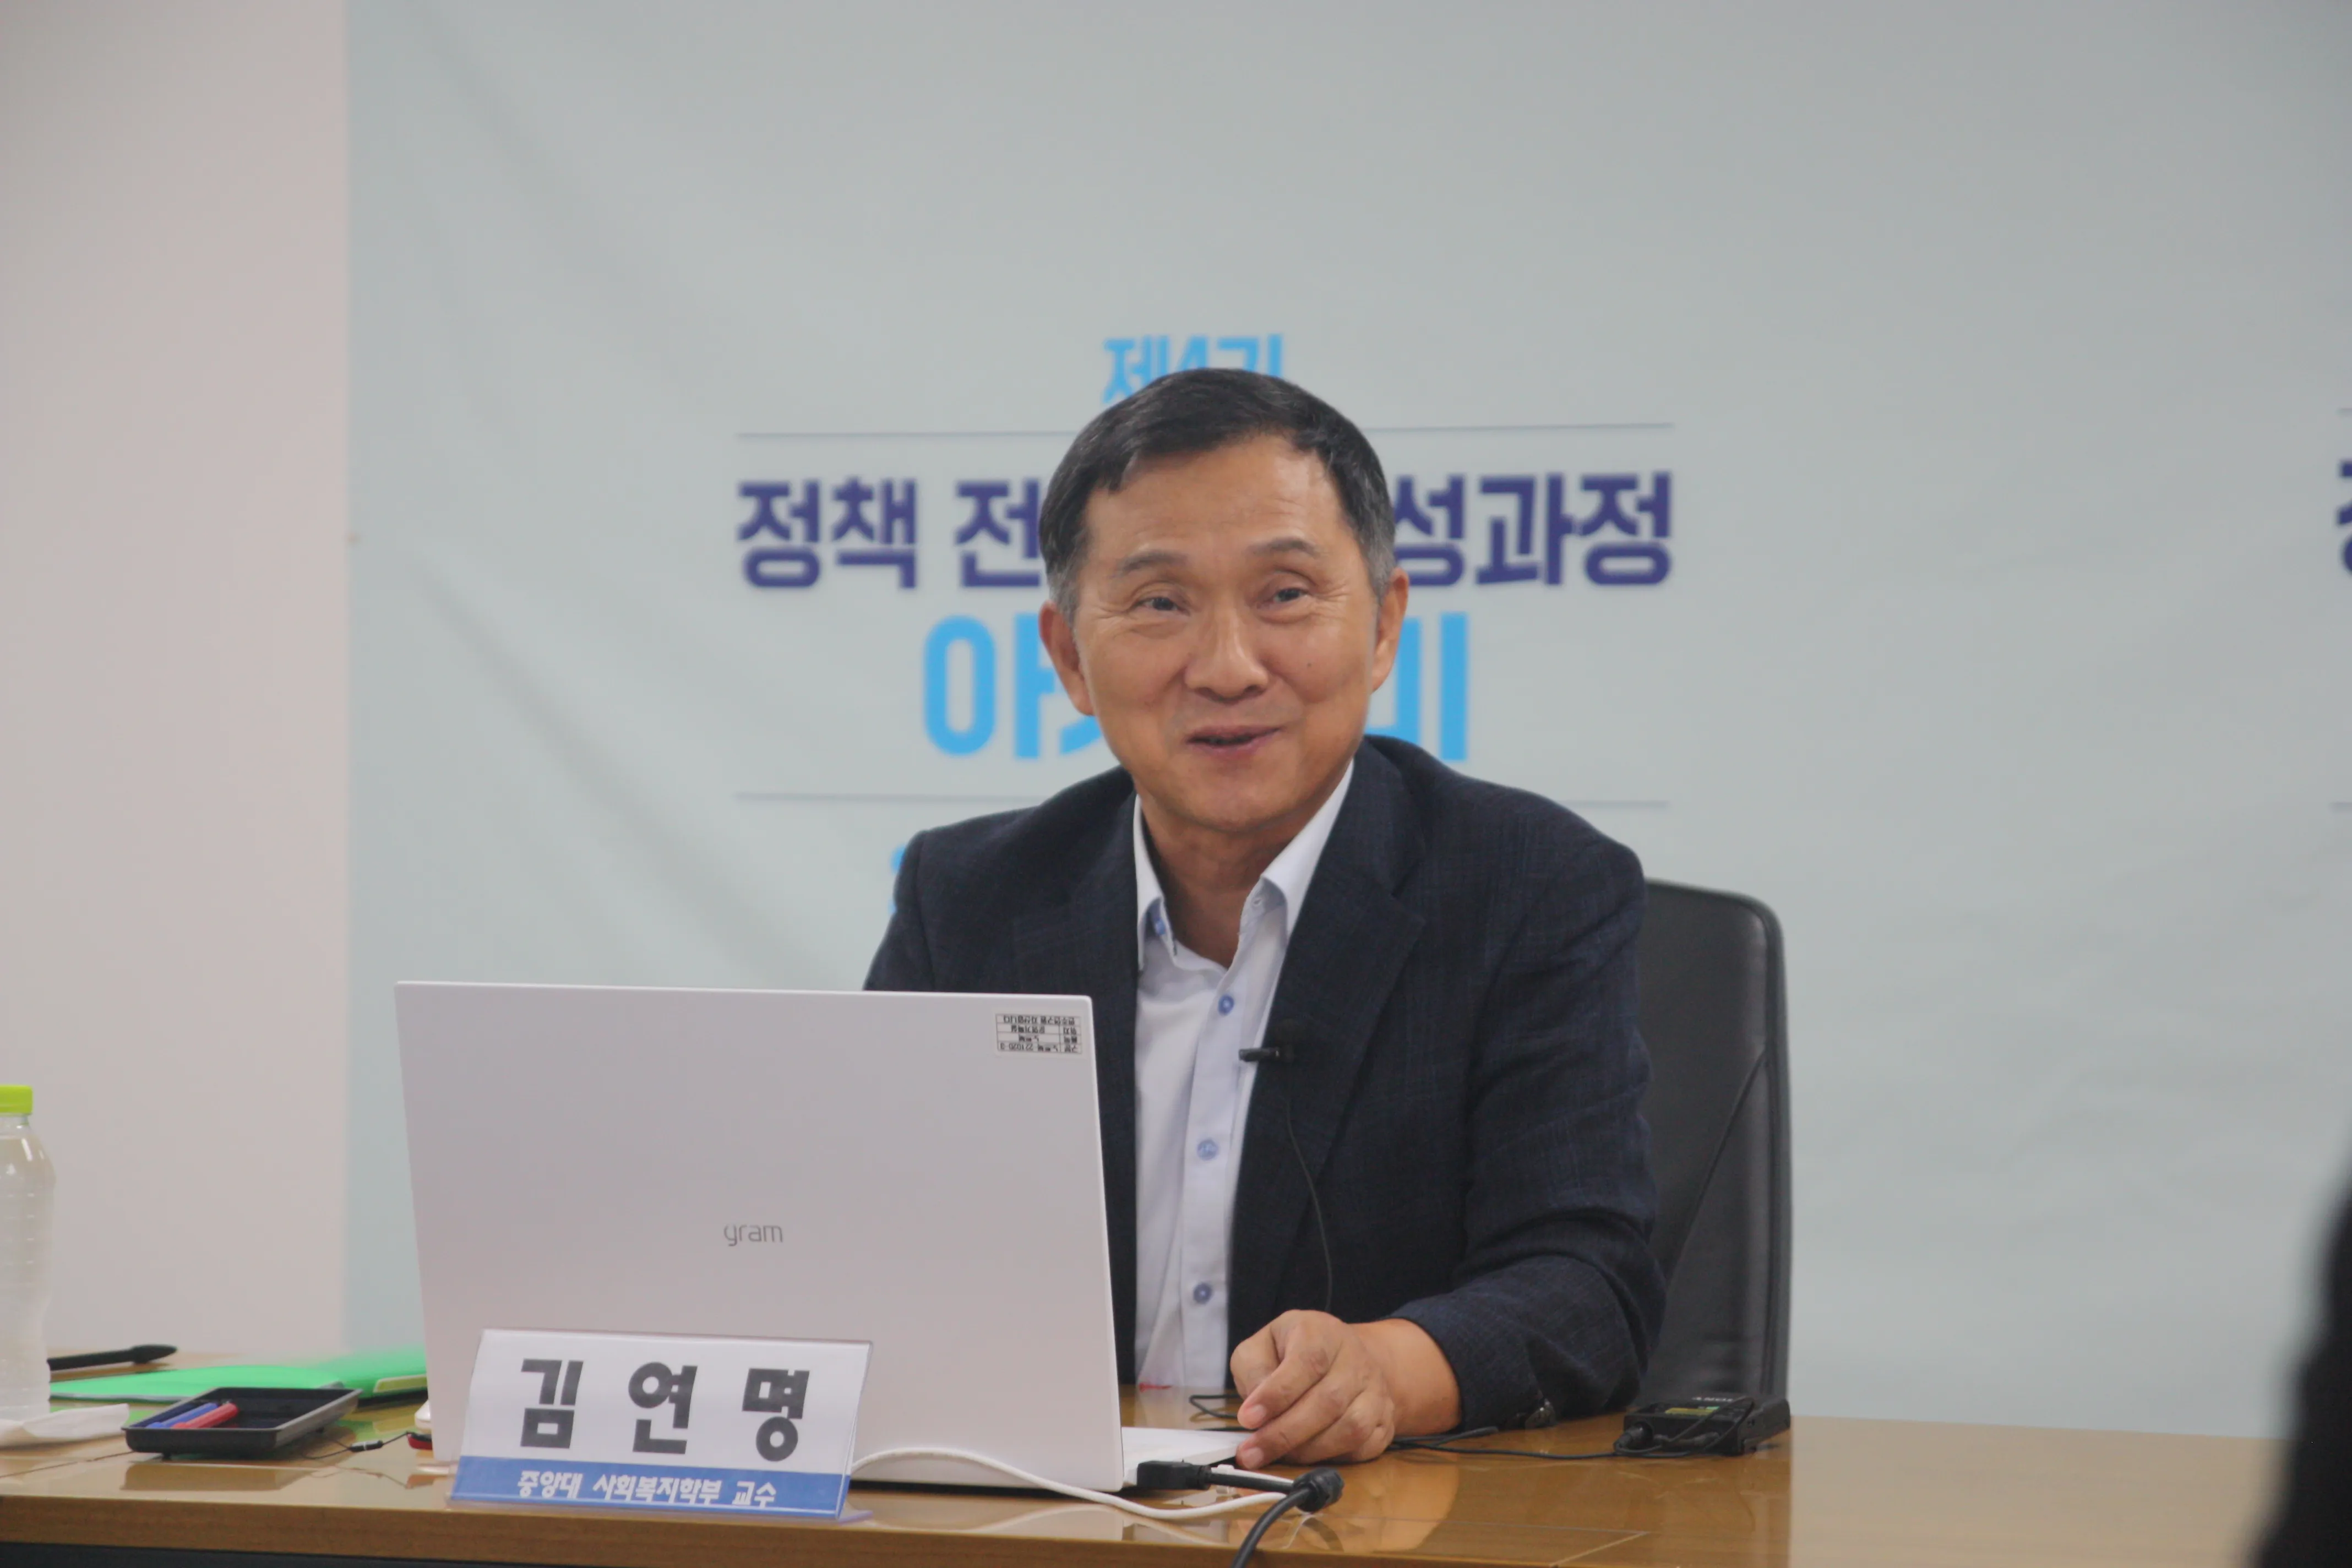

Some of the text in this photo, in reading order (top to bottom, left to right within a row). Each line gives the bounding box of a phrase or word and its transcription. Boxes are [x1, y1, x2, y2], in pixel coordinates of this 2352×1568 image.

[737, 476, 917, 590] 정책
[1394, 472, 1673, 587] 성과정
[517, 1471, 777, 1508] 중앙대 사회복지학부 교수
